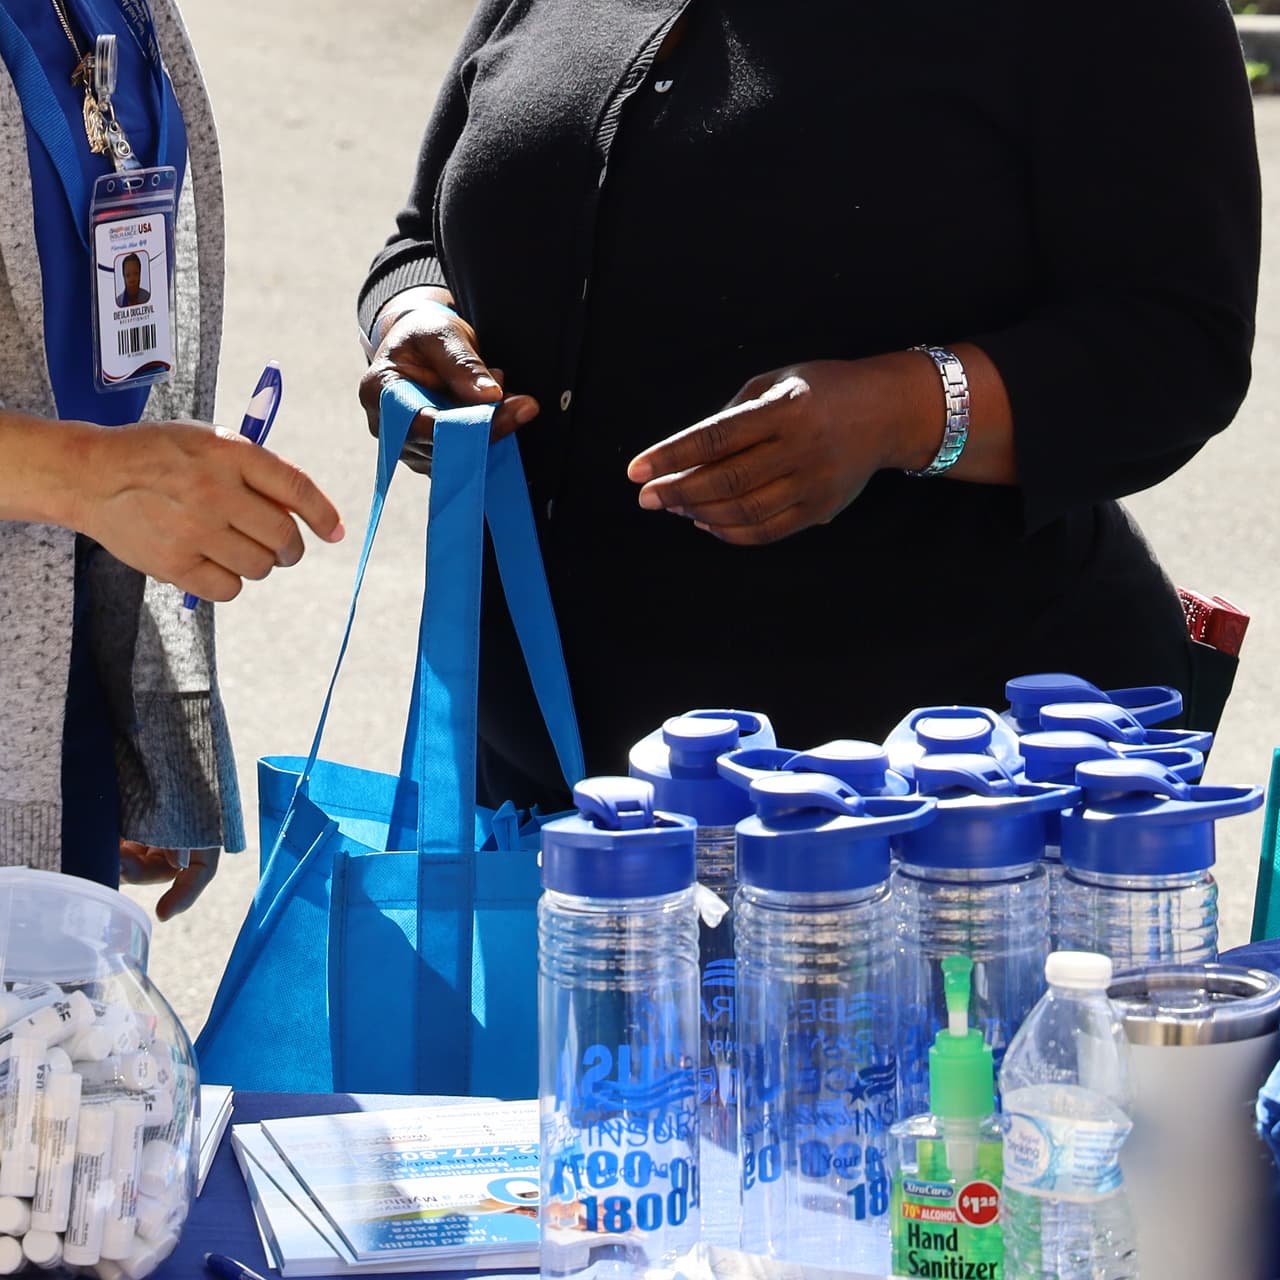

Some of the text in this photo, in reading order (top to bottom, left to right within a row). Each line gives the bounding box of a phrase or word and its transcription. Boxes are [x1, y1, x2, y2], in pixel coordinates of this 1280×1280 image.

[138, 221, 152, 234] USA
[36, 1063, 46, 1090] USA
[407, 1167, 499, 1179] enrollment
[421, 1161, 510, 1173] November
[580, 1187, 688, 1234] 1800
[921, 1208, 957, 1222] ALCOHOL
[378, 1238, 436, 1250] health
[907, 1222, 958, 1252] Hand
[907, 1250, 998, 1280] Sanitizer
